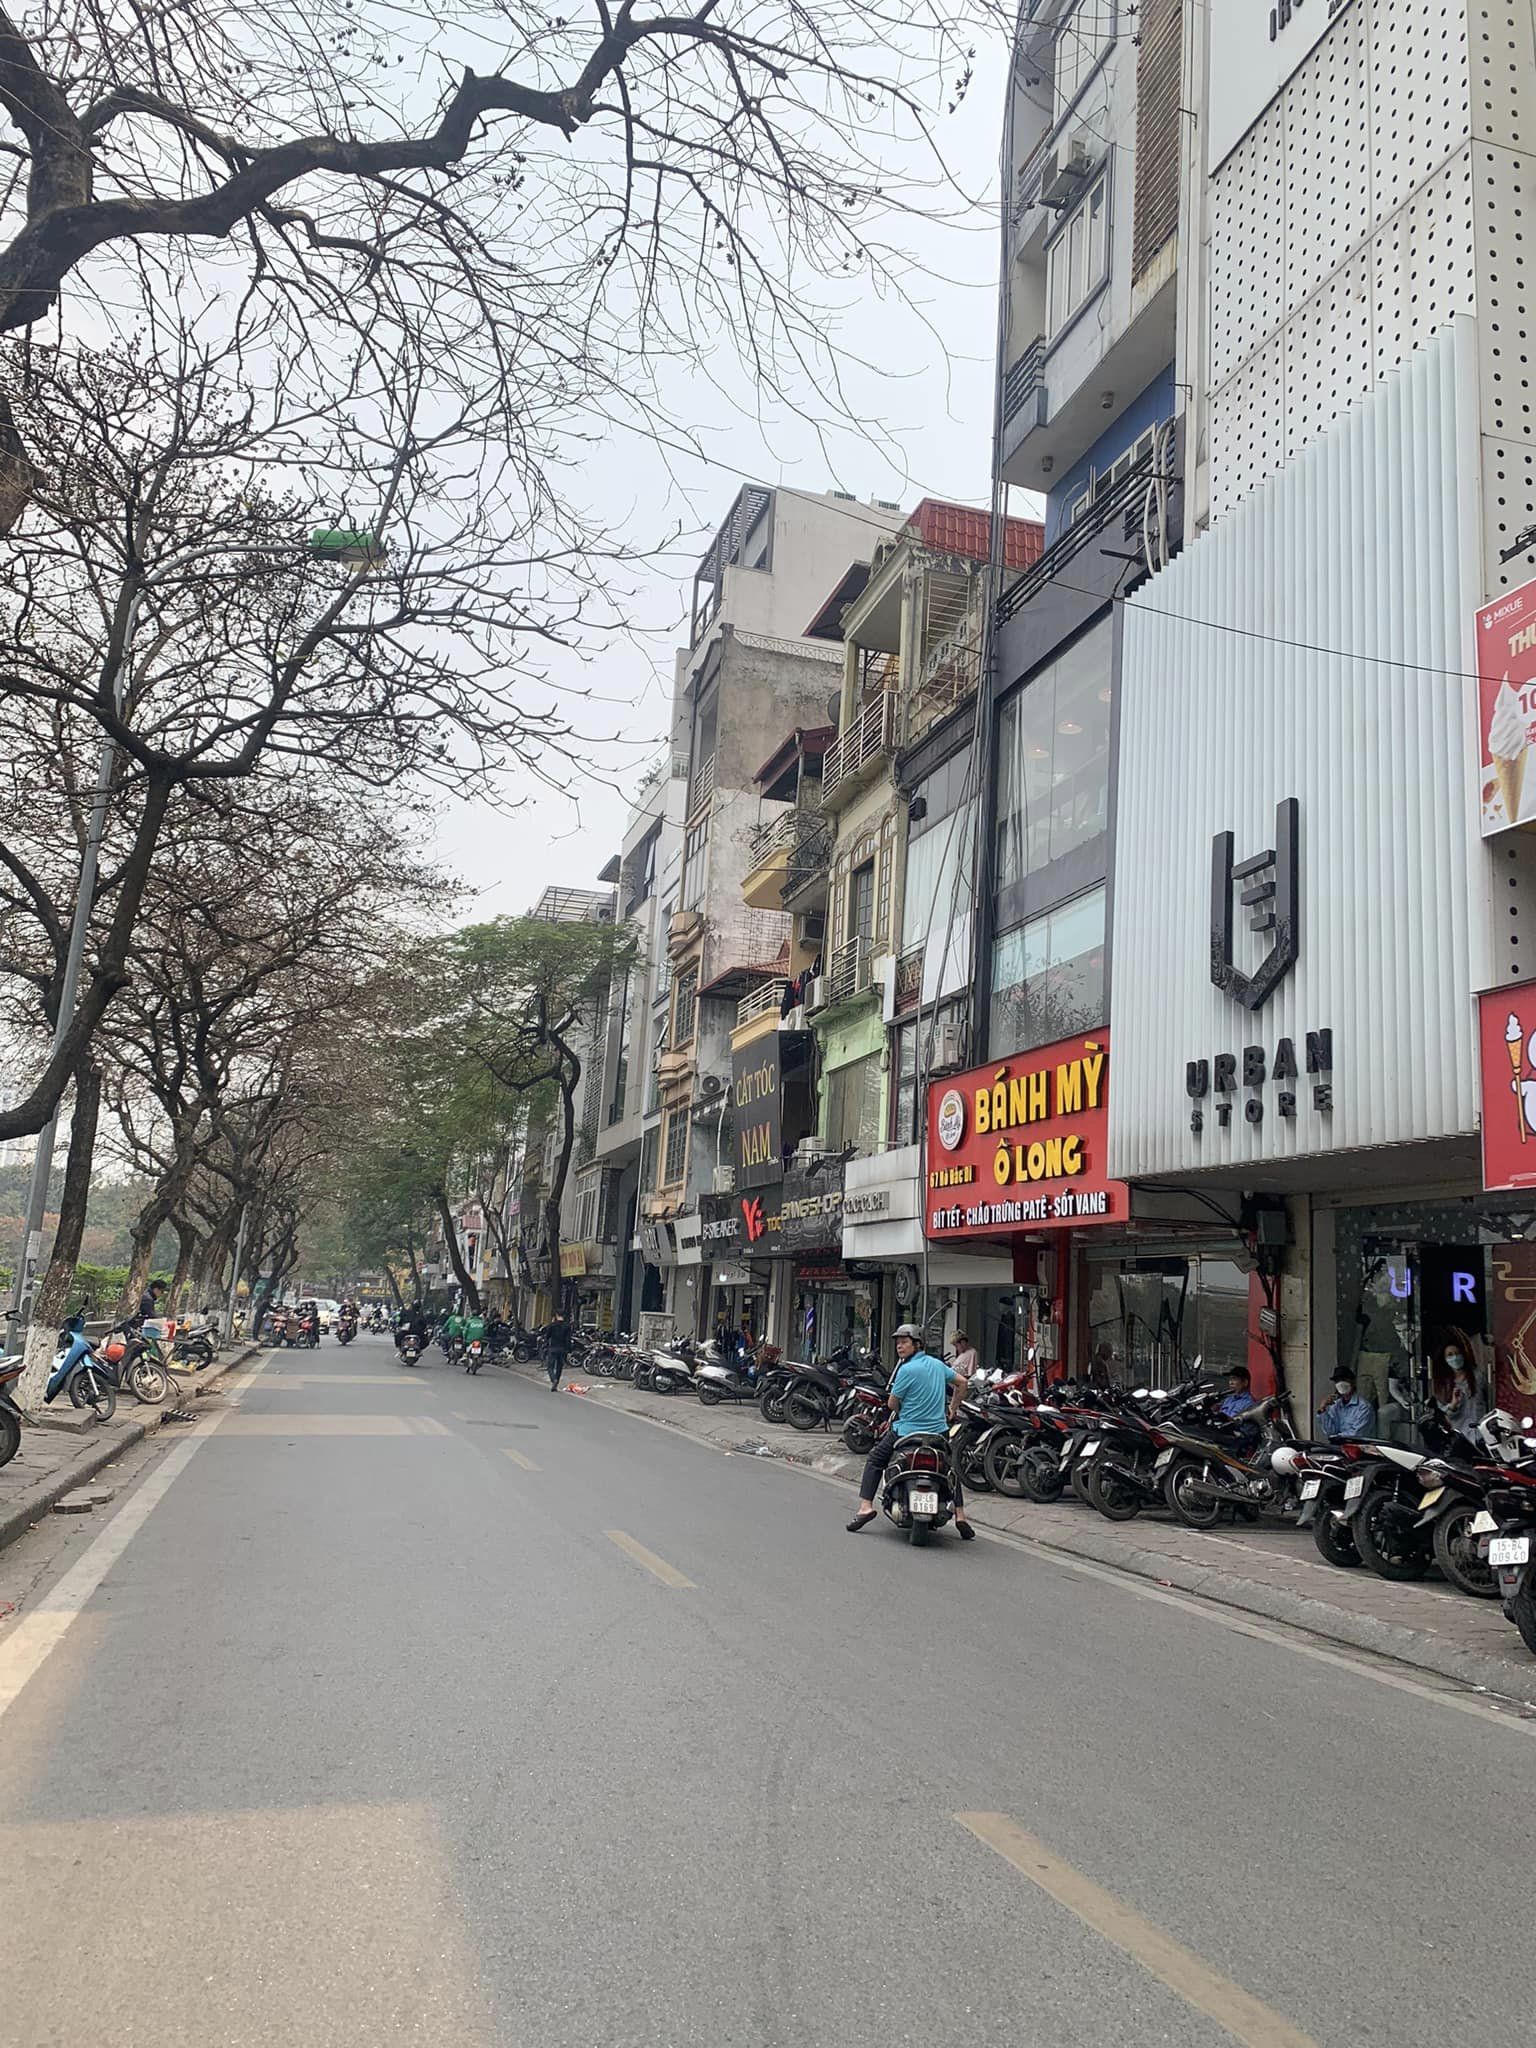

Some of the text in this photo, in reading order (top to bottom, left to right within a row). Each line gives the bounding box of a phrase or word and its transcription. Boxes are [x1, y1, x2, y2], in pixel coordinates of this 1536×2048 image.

[1494, 597, 1523, 621] MIXUE
[1186, 1028, 1333, 1098] URBAN
[975, 1066, 1048, 1134] BÁNH
[1190, 1084, 1333, 1132] STORE
[742, 1121, 771, 1168] NAM
[993, 1135, 1082, 1185] Ô LONG
[1075, 1191, 1107, 1214] VANG
